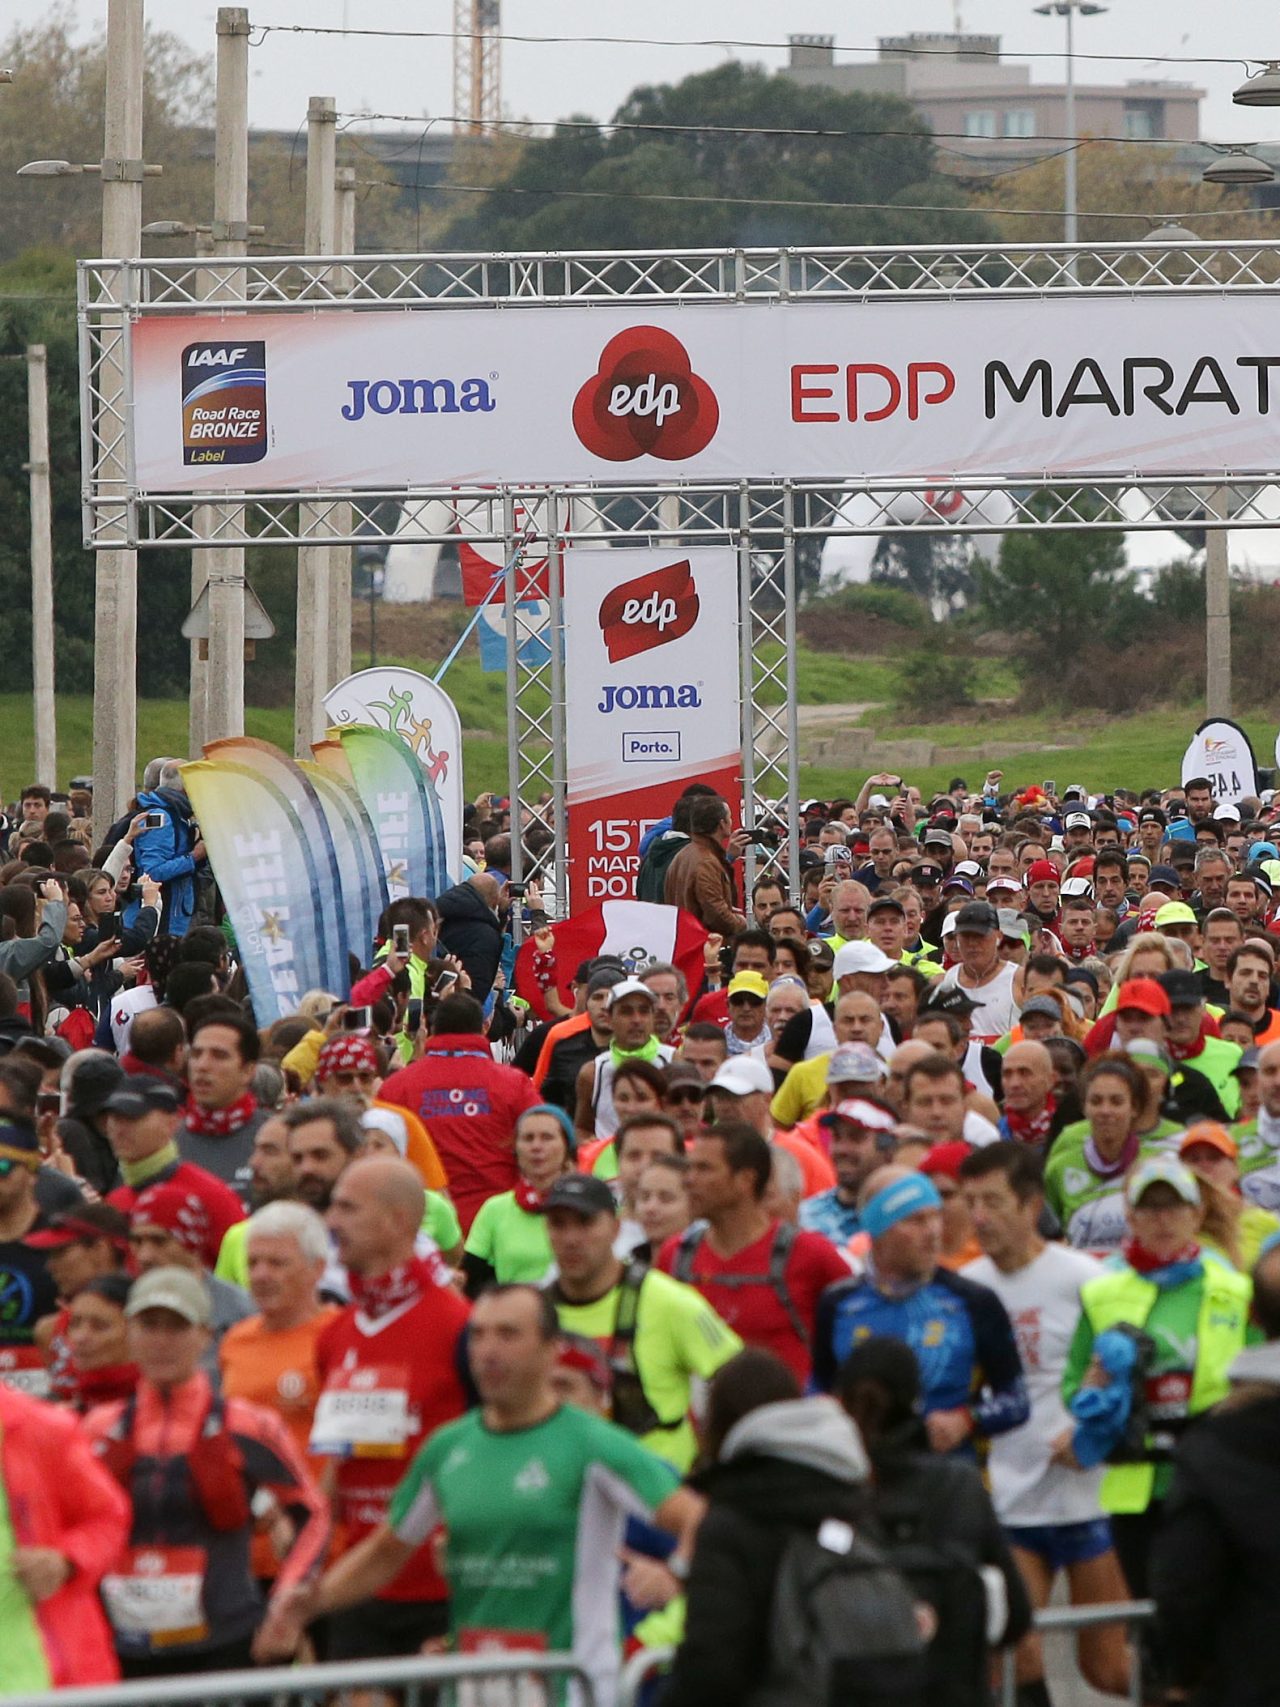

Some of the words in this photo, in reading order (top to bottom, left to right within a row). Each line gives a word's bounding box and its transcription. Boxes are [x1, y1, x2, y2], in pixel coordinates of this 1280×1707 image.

[187, 348, 248, 367] IAAF
[607, 373, 682, 426] edp
[791, 361, 956, 423] EDP
[191, 407, 227, 420] Road
[228, 406, 260, 420] Race
[189, 421, 261, 439] BRONZE
[190, 449, 225, 462] Label
[621, 590, 677, 631] edp
[630, 741, 673, 753] Porto.
[588, 875, 628, 897] DO
